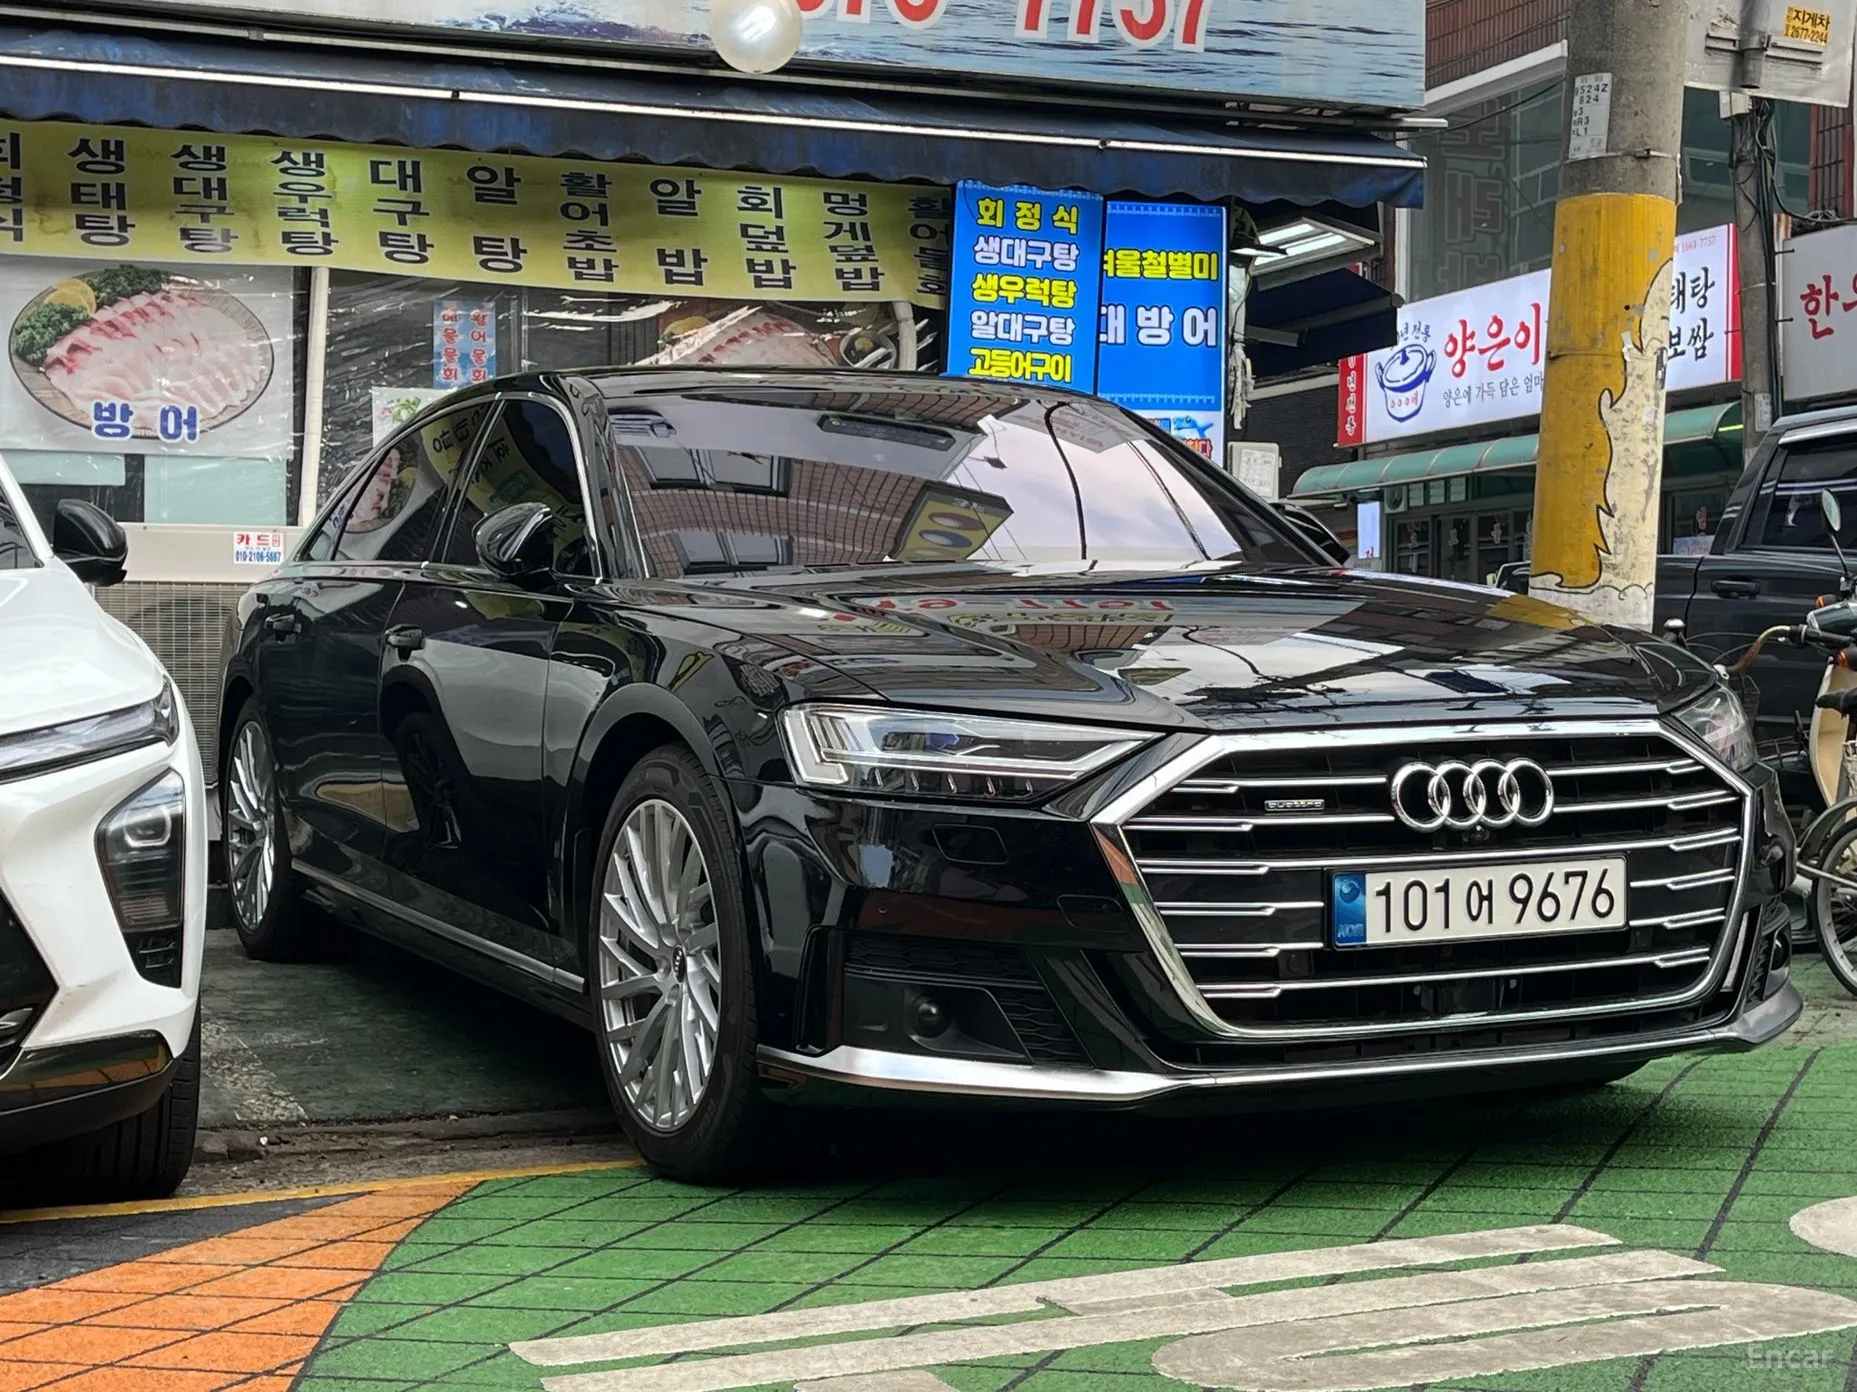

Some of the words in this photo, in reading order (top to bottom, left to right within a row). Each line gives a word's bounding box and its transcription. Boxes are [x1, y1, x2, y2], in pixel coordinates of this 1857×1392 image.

[1793, 9, 1831, 31] 지게차
[68, 138, 136, 247] 생태탕
[170, 144, 239, 253] 생대구탕
[270, 151, 339, 256] 생우럭탕
[369, 159, 434, 264] 대구탕
[466, 165, 528, 273] 알탕
[559, 172, 619, 283] 활어초밥
[737, 185, 797, 289] 회덮밥
[822, 190, 884, 292] 멍게덮밥
[971, 273, 1077, 309] 생우럭탕
[973, 235, 1080, 272] 생대구탕
[969, 348, 1073, 383] 고등어구이
[970, 309, 1076, 346] 알대구탕
[1444, 302, 1541, 378] 양은이
